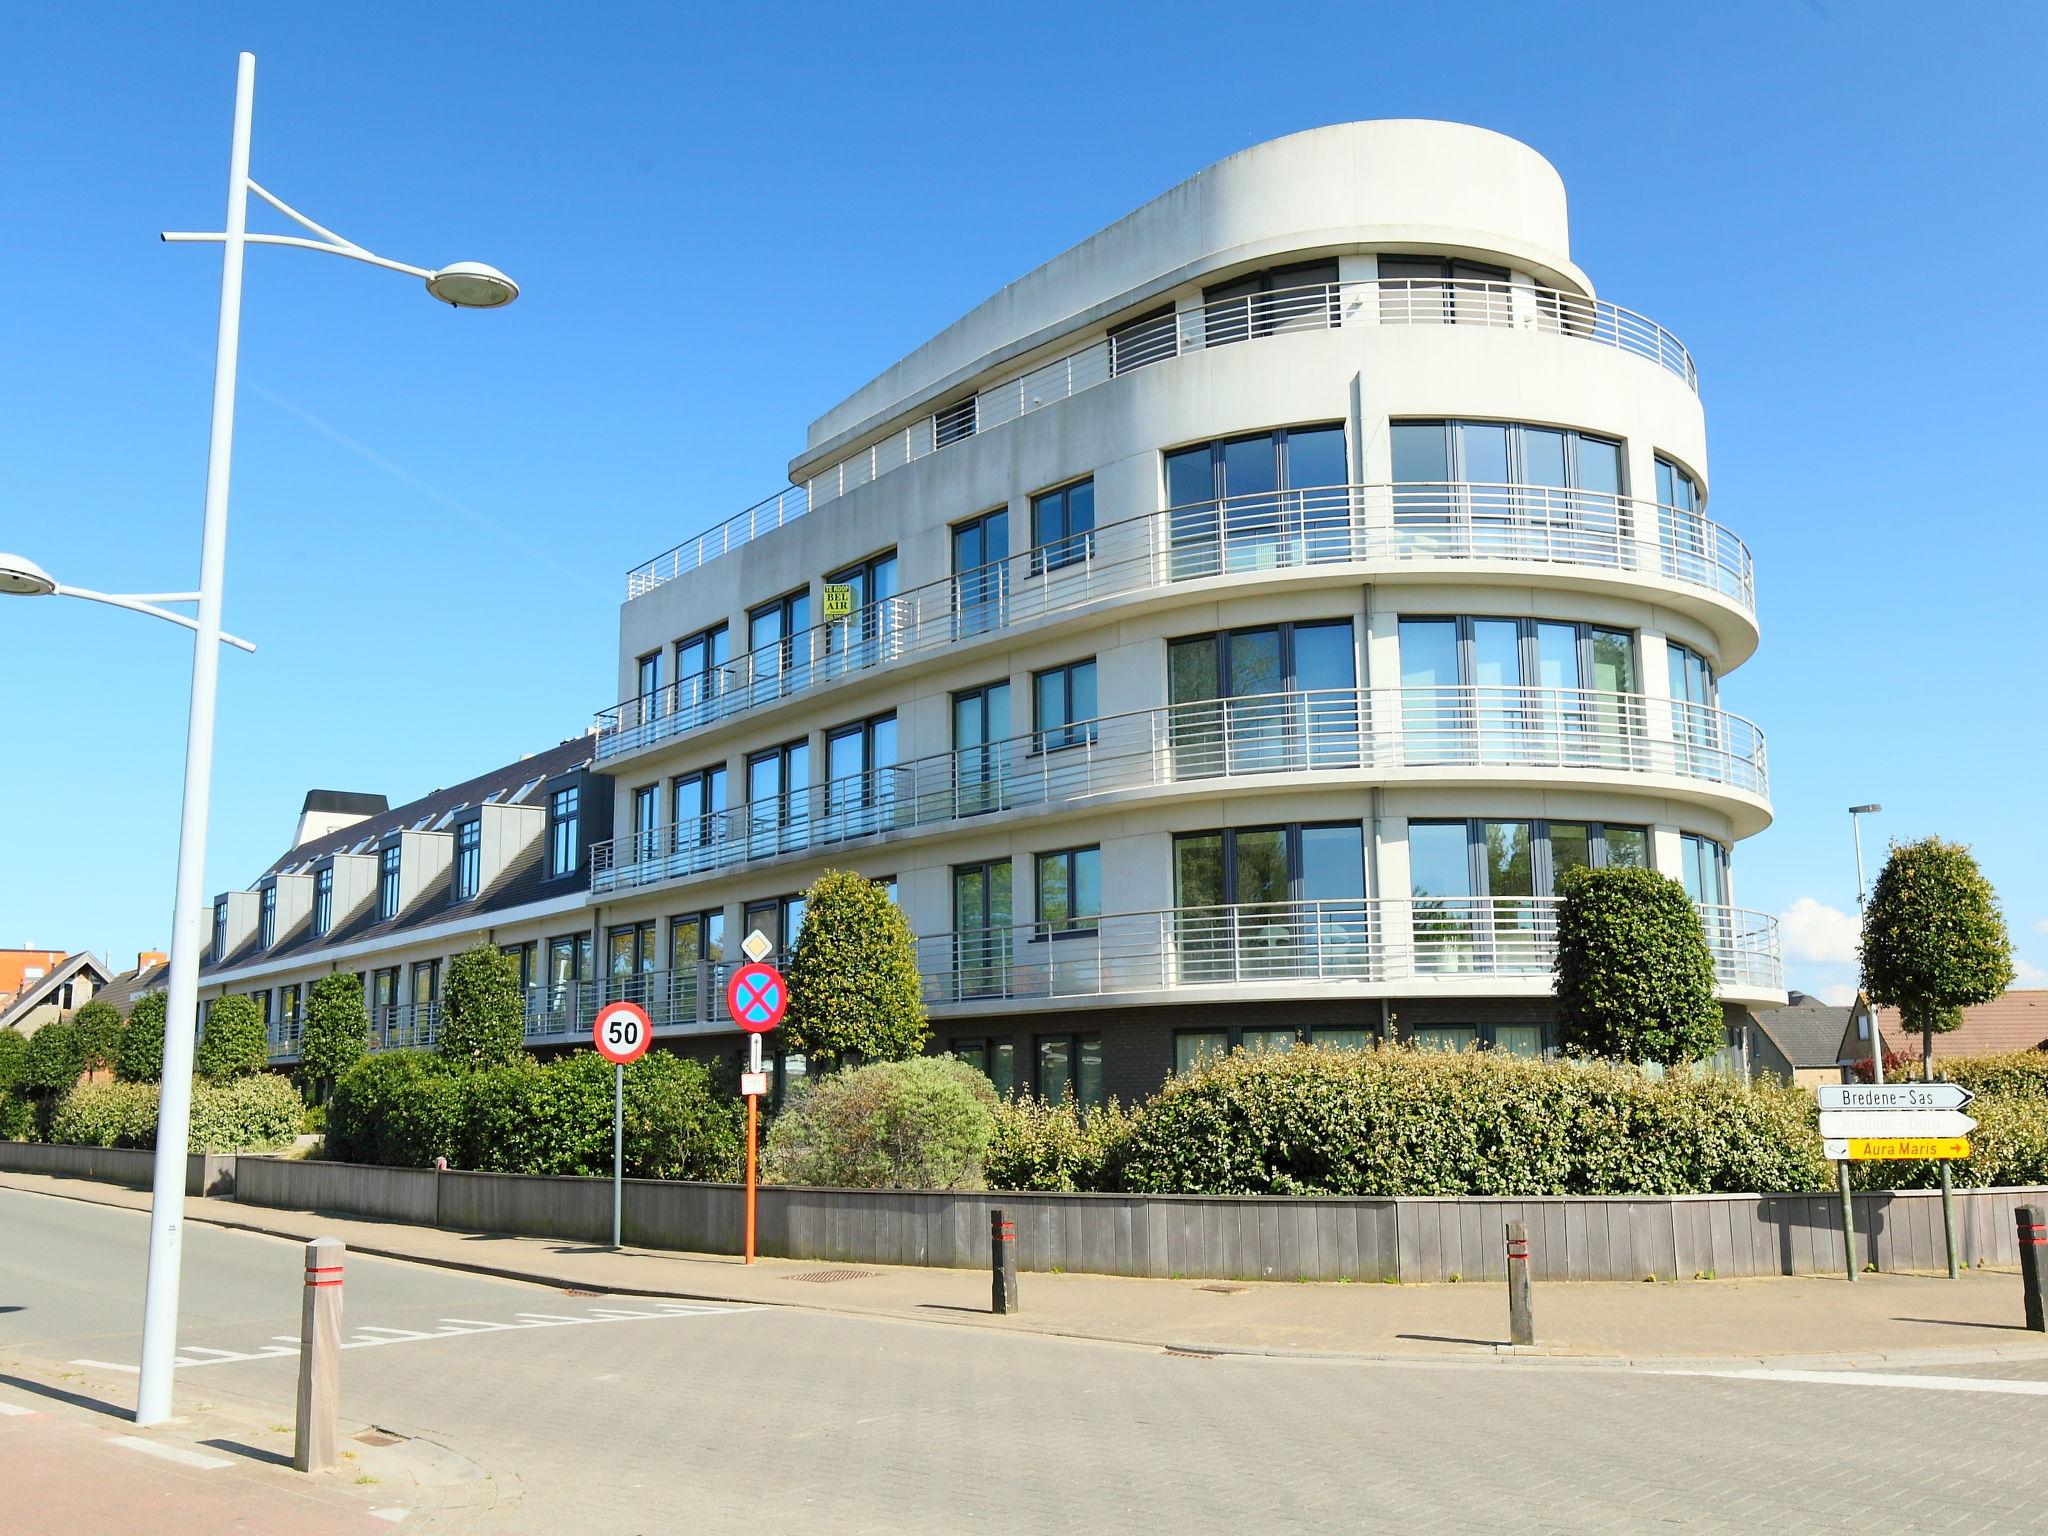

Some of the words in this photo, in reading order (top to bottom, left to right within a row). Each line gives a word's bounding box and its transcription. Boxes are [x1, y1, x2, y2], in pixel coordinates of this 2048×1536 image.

[827, 602, 848, 610] AIR
[609, 1022, 637, 1044] 50
[1863, 1143, 1894, 1155] Aura
[1900, 1142, 1937, 1155] Maris
